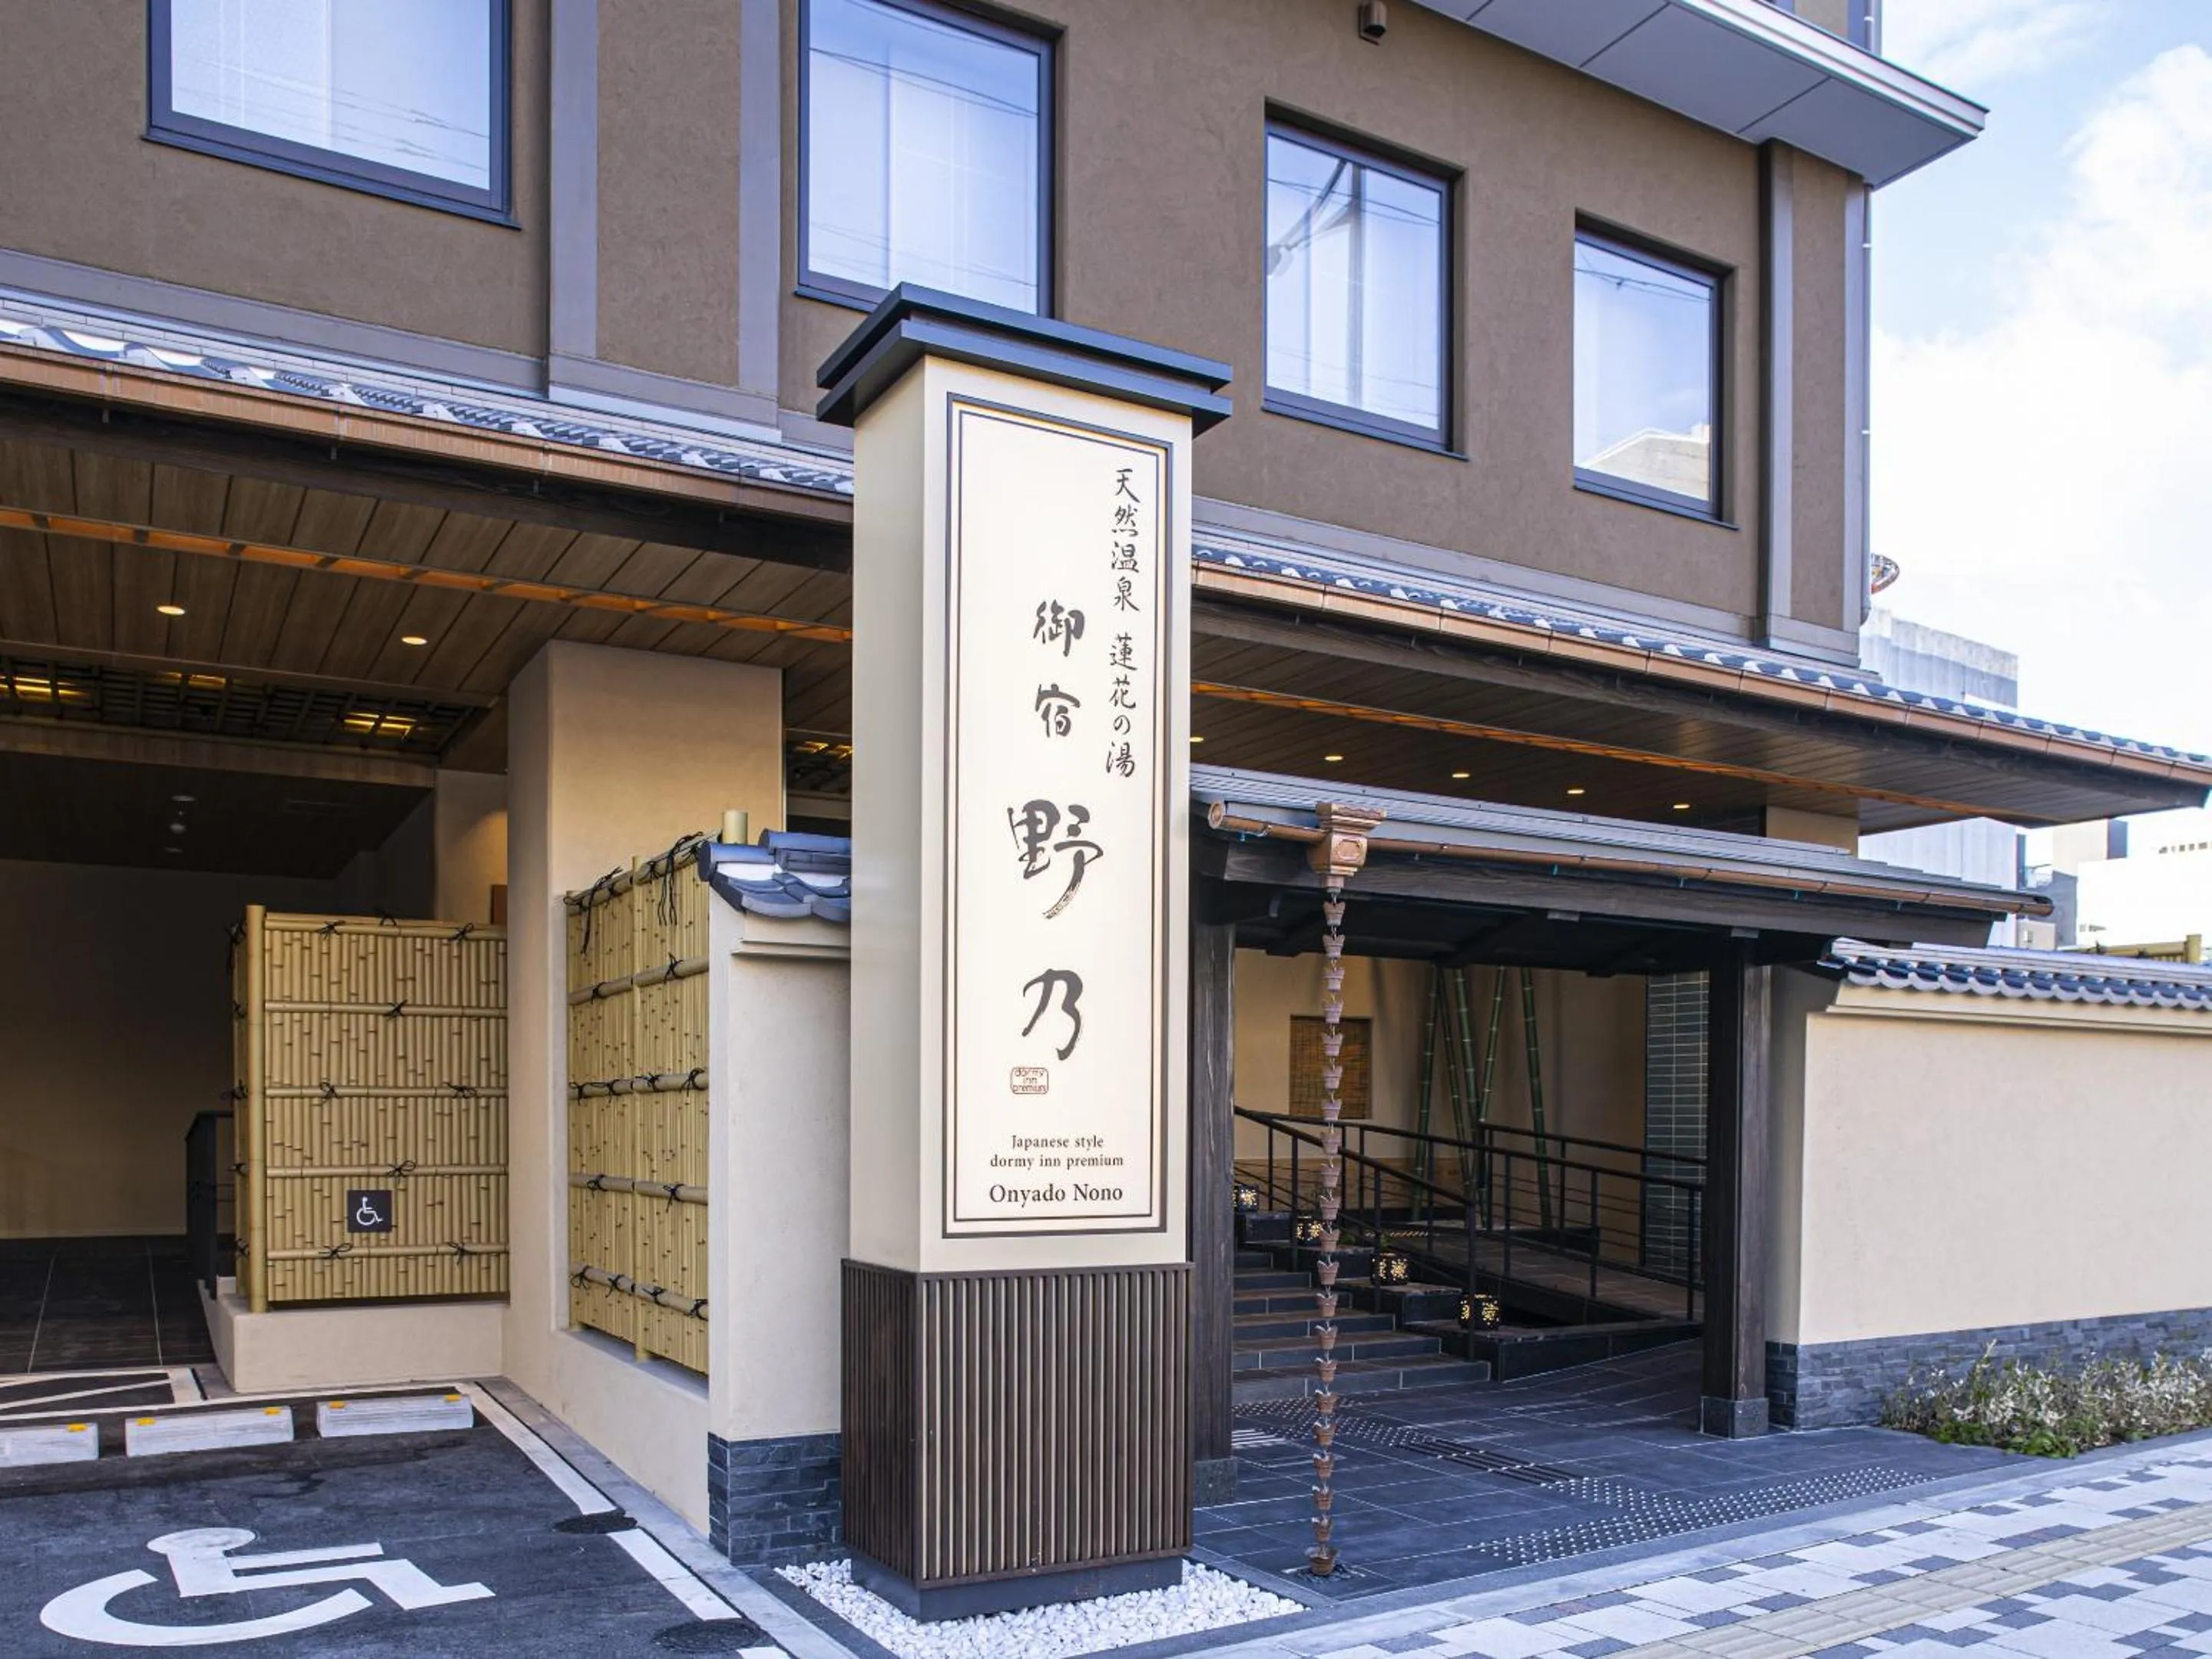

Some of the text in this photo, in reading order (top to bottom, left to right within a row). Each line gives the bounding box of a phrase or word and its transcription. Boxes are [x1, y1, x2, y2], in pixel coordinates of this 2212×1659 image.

[1105, 468, 1141, 778] 天然温泉 蓮花の湯
[1006, 599, 1104, 1061] 御宿 野乃
[1012, 1134, 1104, 1151] Japanese style
[990, 1154, 1124, 1171] dormy inn premium
[988, 1183, 1124, 1208] Onyado Nono
